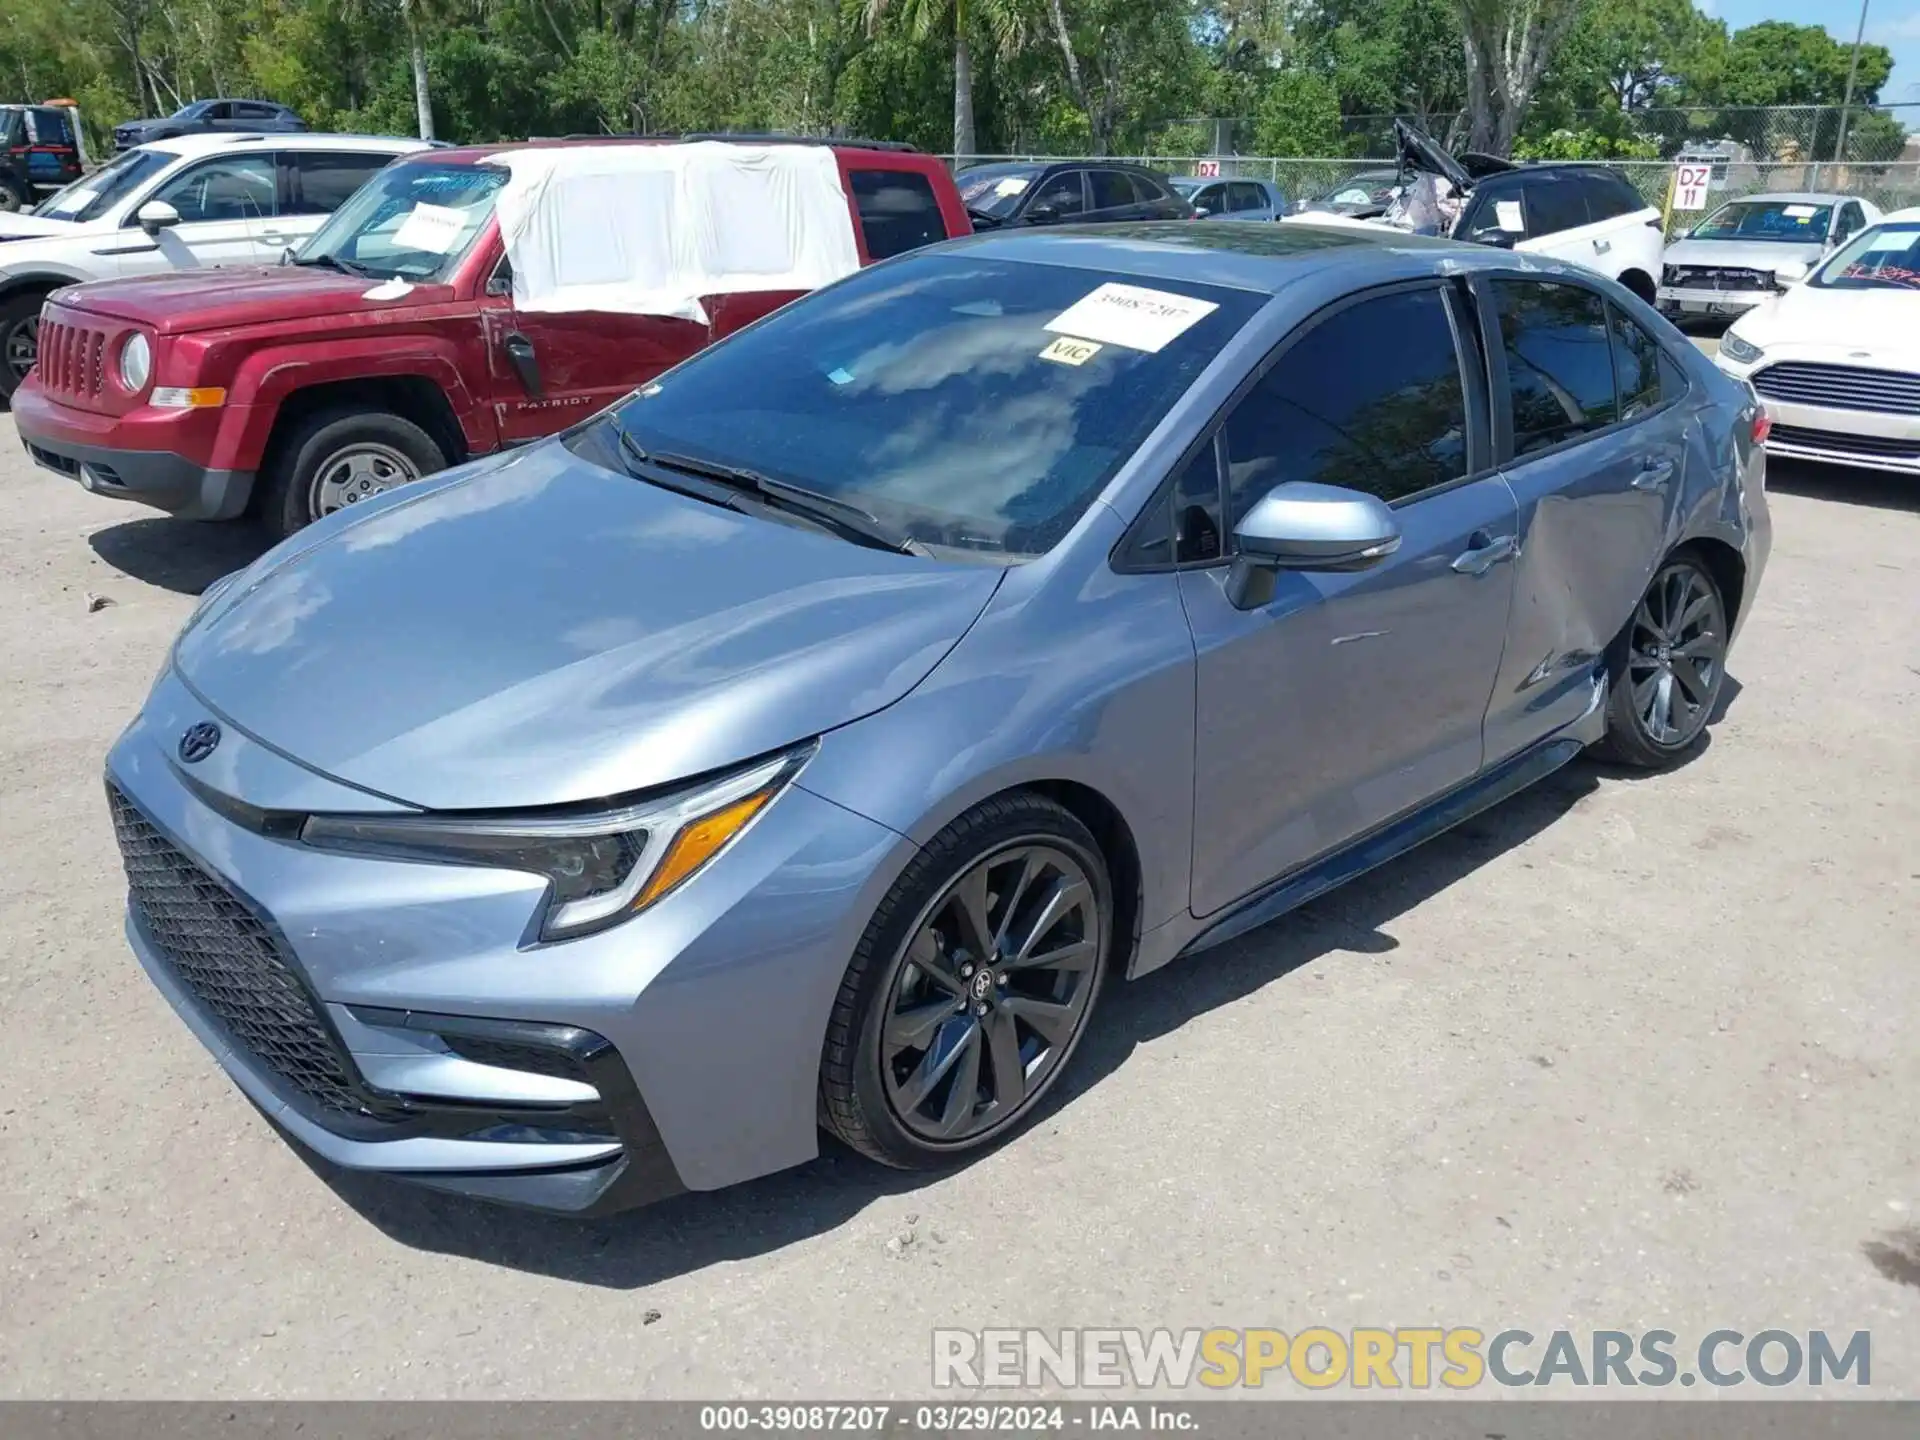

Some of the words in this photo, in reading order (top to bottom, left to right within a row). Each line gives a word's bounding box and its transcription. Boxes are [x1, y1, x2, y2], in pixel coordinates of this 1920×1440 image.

[1200, 163, 1217, 177] DZ
[1680, 168, 1708, 186] DZ
[1683, 188, 1697, 206] 11
[1053, 342, 1091, 360] VIC
[517, 396, 592, 409] PATRIOT
